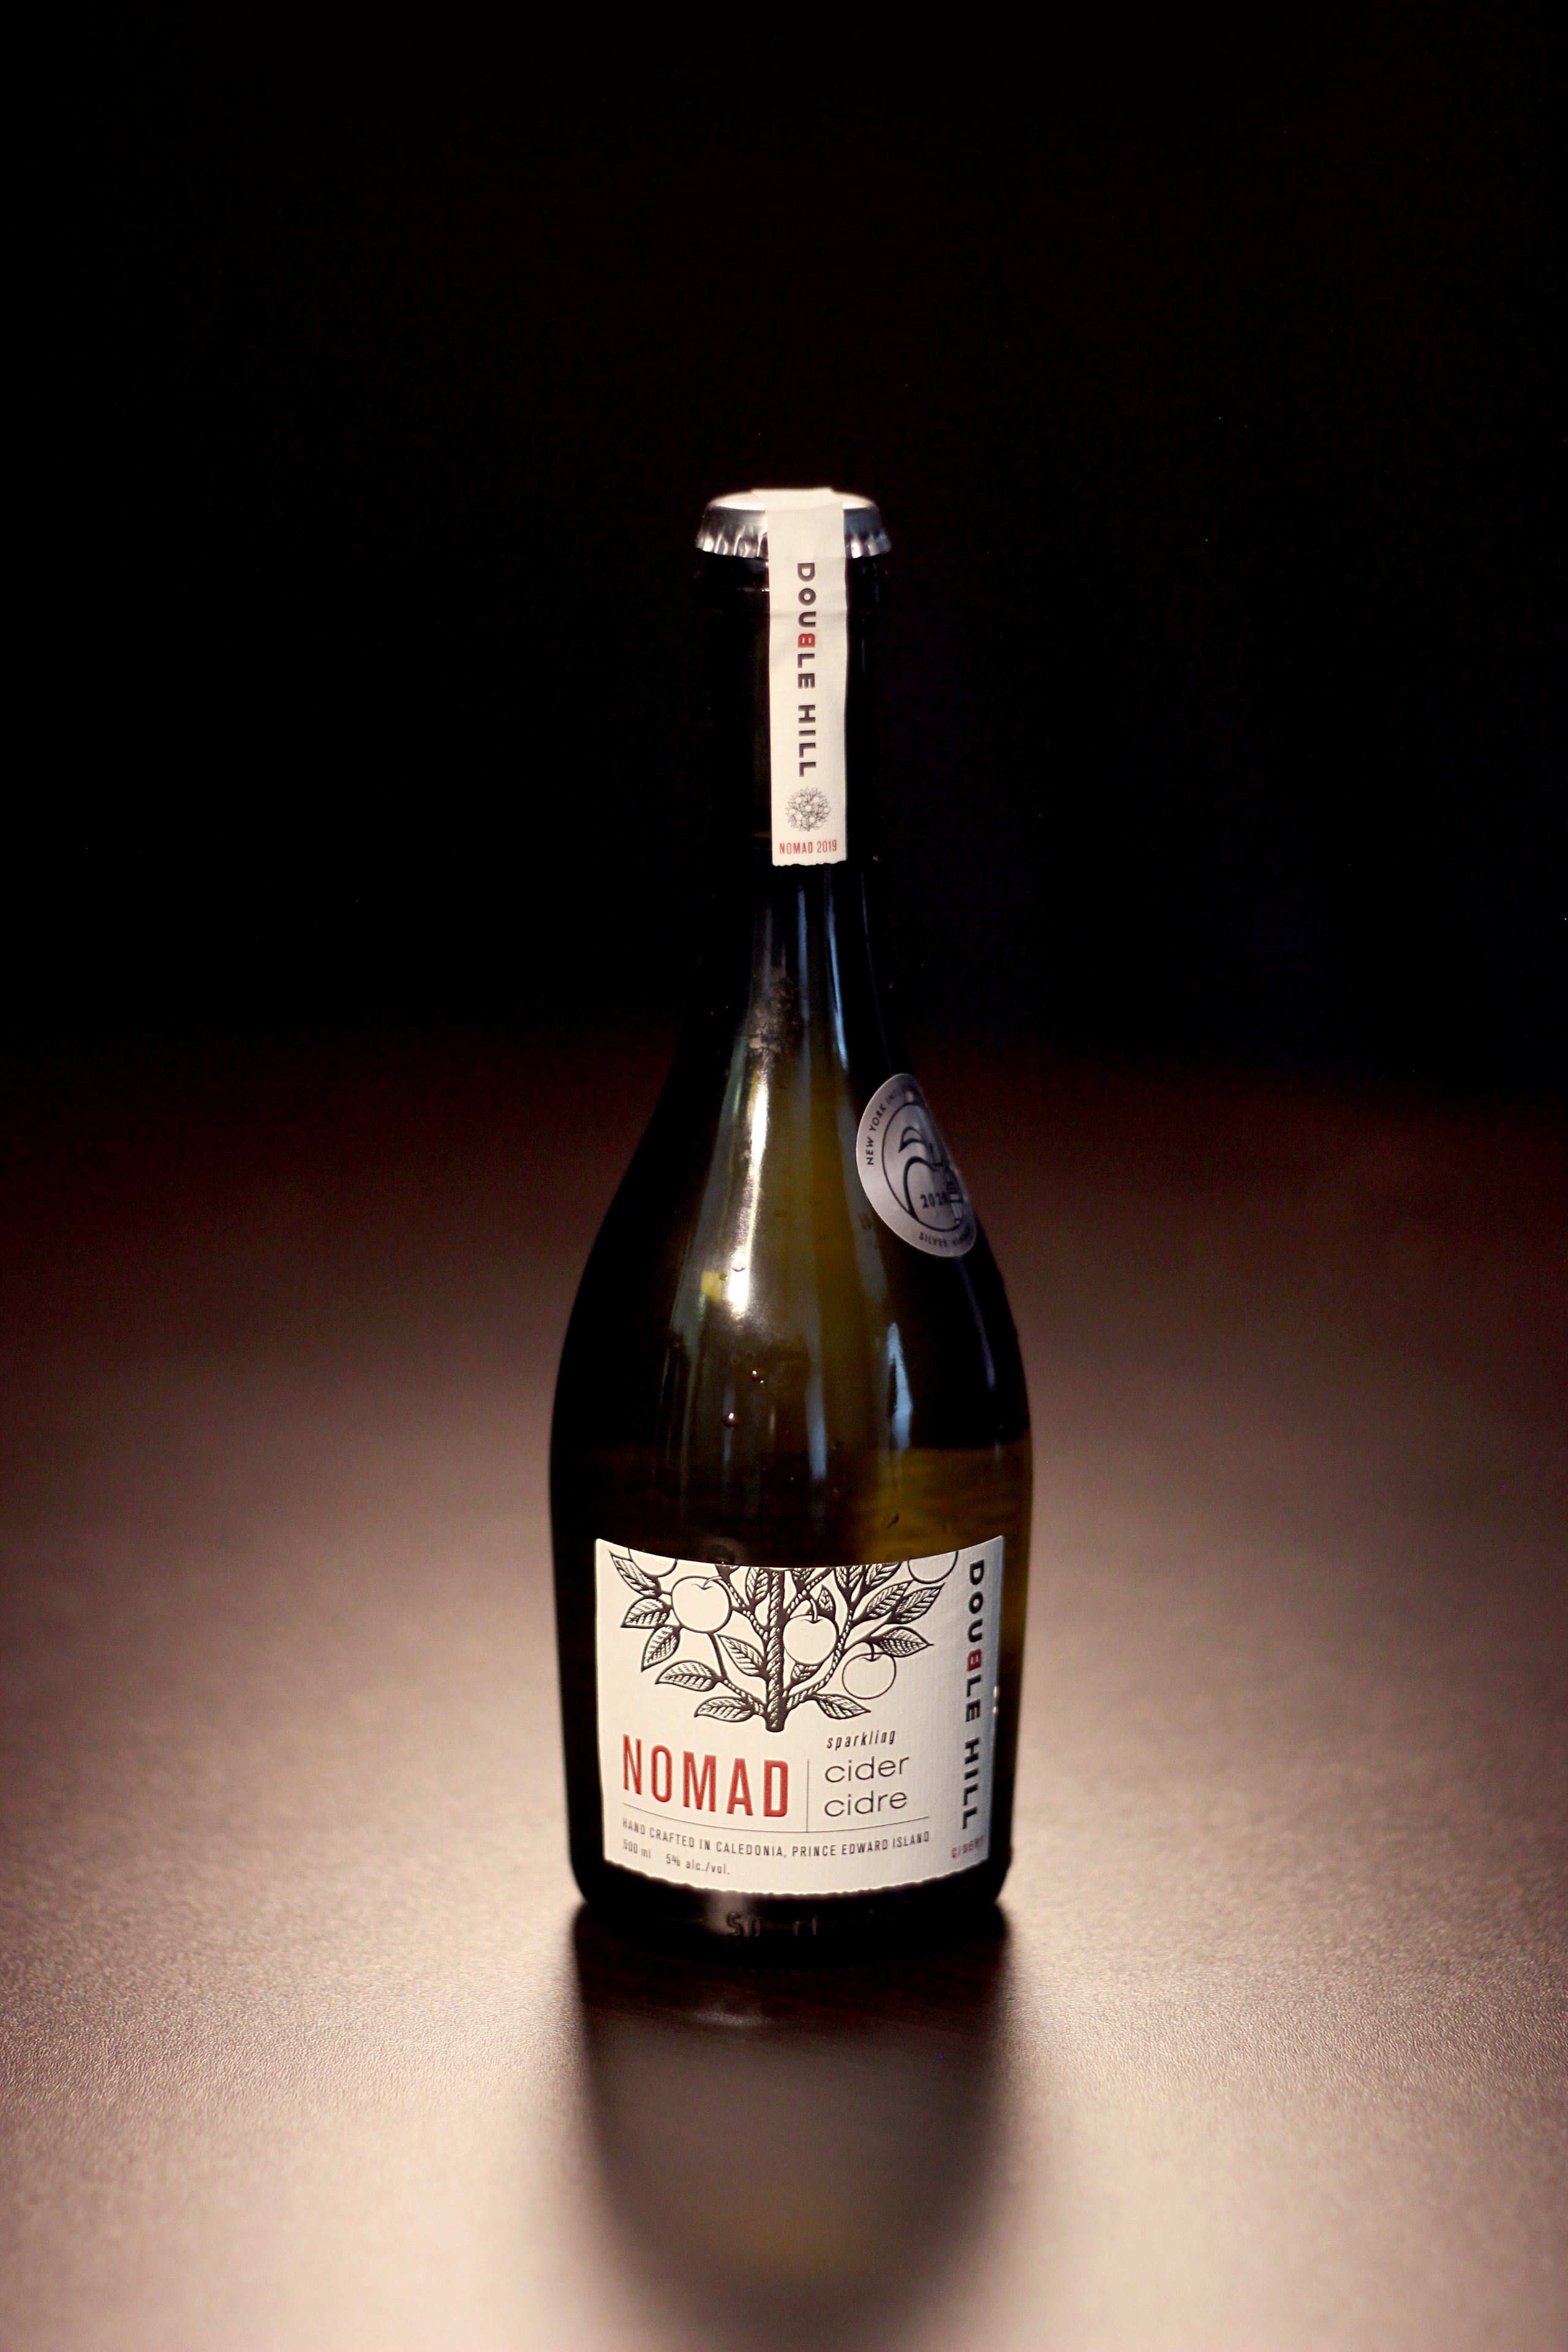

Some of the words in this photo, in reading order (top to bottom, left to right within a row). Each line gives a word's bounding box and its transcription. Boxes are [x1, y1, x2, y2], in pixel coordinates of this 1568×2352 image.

[797, 562, 816, 689] DOUBLE
[798, 704, 816, 777] HILL
[779, 842, 813, 855] NOMAD
[816, 840, 837, 853] 2019
[869, 1104, 886, 1132] YORK
[919, 1232, 948, 1248] SILVER
[966, 1559, 984, 1722] DOUBLE
[826, 1730, 896, 1751] sparkling
[622, 1733, 789, 1818] NOMAD
[824, 1755, 910, 1783] cider
[962, 1736, 979, 1830] HILL
[824, 1790, 908, 1817] cidre
[622, 1817, 646, 1835] HAND
[649, 1826, 695, 1848] CRAFTED
[699, 1839, 710, 1850] IN
[716, 1841, 787, 1858] CALEDONIA,
[792, 1844, 836, 1857] PRINCE
[841, 1838, 888, 1855] EDWARD
[892, 1830, 930, 1848] ISLAND
[623, 1839, 638, 1853] 500
[641, 1848, 651, 1858] ml
[666, 1853, 680, 1866] 5%
[685, 1858, 731, 1875] alc./vol.
